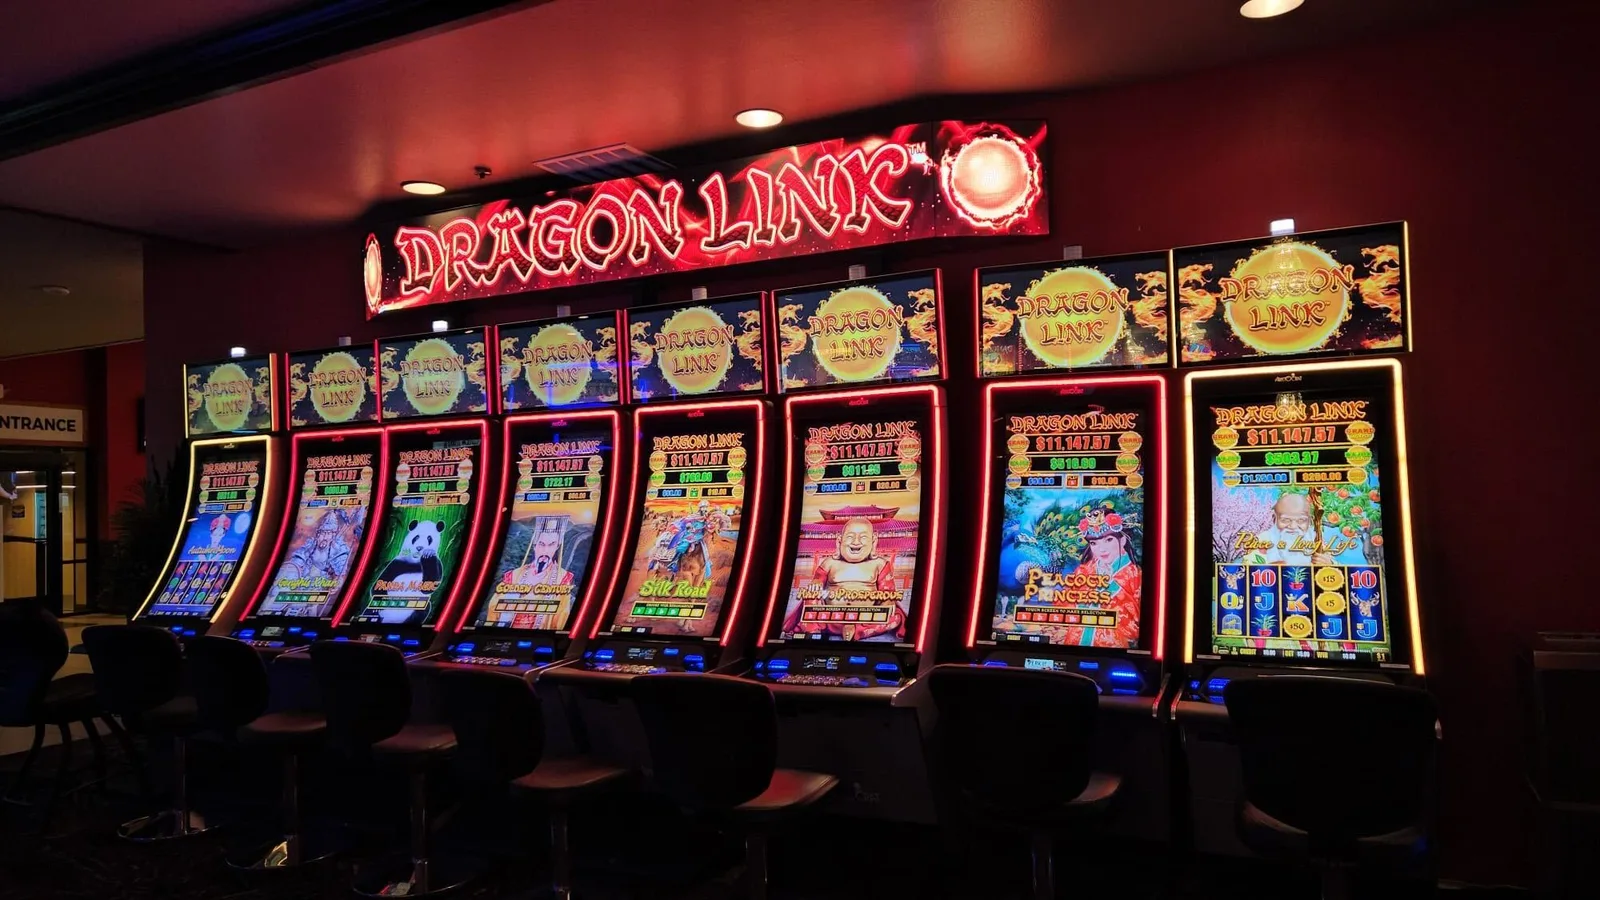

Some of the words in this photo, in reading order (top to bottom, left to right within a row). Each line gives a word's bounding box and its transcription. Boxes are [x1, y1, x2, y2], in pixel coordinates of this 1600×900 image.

[395, 181, 684, 295] DRAGON
[700, 143, 913, 254] LINK
[1218, 264, 1356, 302] DRAGON
[1014, 287, 1129, 320] DRAGON
[808, 304, 905, 337] DRAGON
[1249, 300, 1326, 331] LINK
[654, 325, 734, 353] DRAGON
[1040, 319, 1104, 346] LINK
[521, 341, 593, 365] DRAGON
[829, 336, 884, 362] LINK
[399, 355, 464, 375] DRAGON
[672, 354, 718, 376] LINK
[203, 377, 253, 398] DRAGON
[308, 367, 367, 388] DRAGON
[538, 367, 579, 388] LINK
[321, 389, 356, 407] LINK
[414, 379, 451, 398] LINK
[214, 399, 244, 417] LINK
[1215, 404, 1307, 425] DRAGON
[1310, 401, 1367, 420] LINK
[808, 423, 873, 441] DRAGON
[875, 421, 914, 437] LINK
[1010, 415, 1087, 432] DRAGON
[1089, 413, 1136, 430] LINK
[521, 442, 569, 457] DRAGON
[653, 434, 708, 451] DRAGON
[709, 433, 742, 448] LINK
[1234, 531, 1275, 550] Peace
[1277, 540, 1286, 550] &
[1288, 535, 1321, 556] Long
[1323, 535, 1358, 556] Life
[1251, 569, 1276, 587] 10
[1350, 569, 1377, 589] 10
[639, 580, 673, 597] Silk
[674, 579, 712, 598] Road
[1255, 592, 1275, 611] J
[1286, 594, 1309, 612] K
[1322, 618, 1343, 637] J
[1357, 619, 1377, 638] J
